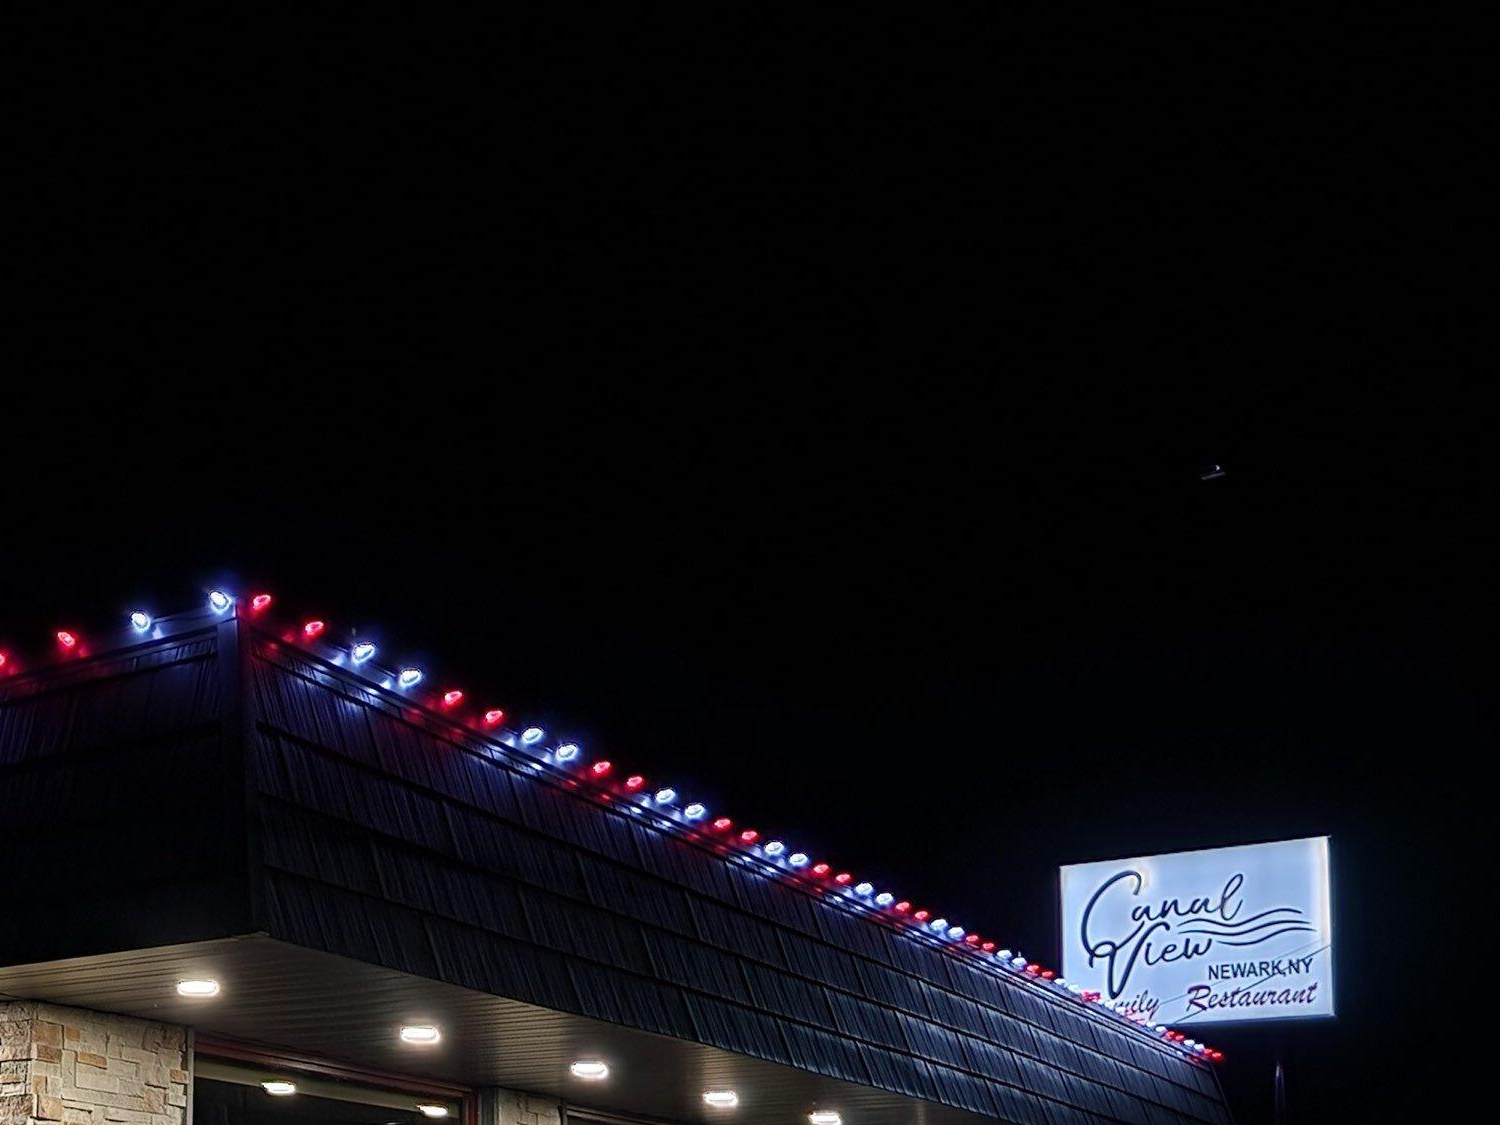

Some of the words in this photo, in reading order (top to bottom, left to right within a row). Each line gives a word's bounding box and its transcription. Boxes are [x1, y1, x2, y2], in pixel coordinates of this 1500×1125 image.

[1081, 870, 1243, 956] Canal
[1088, 921, 1213, 999] View
[1186, 982, 1318, 1011] Restaurant
